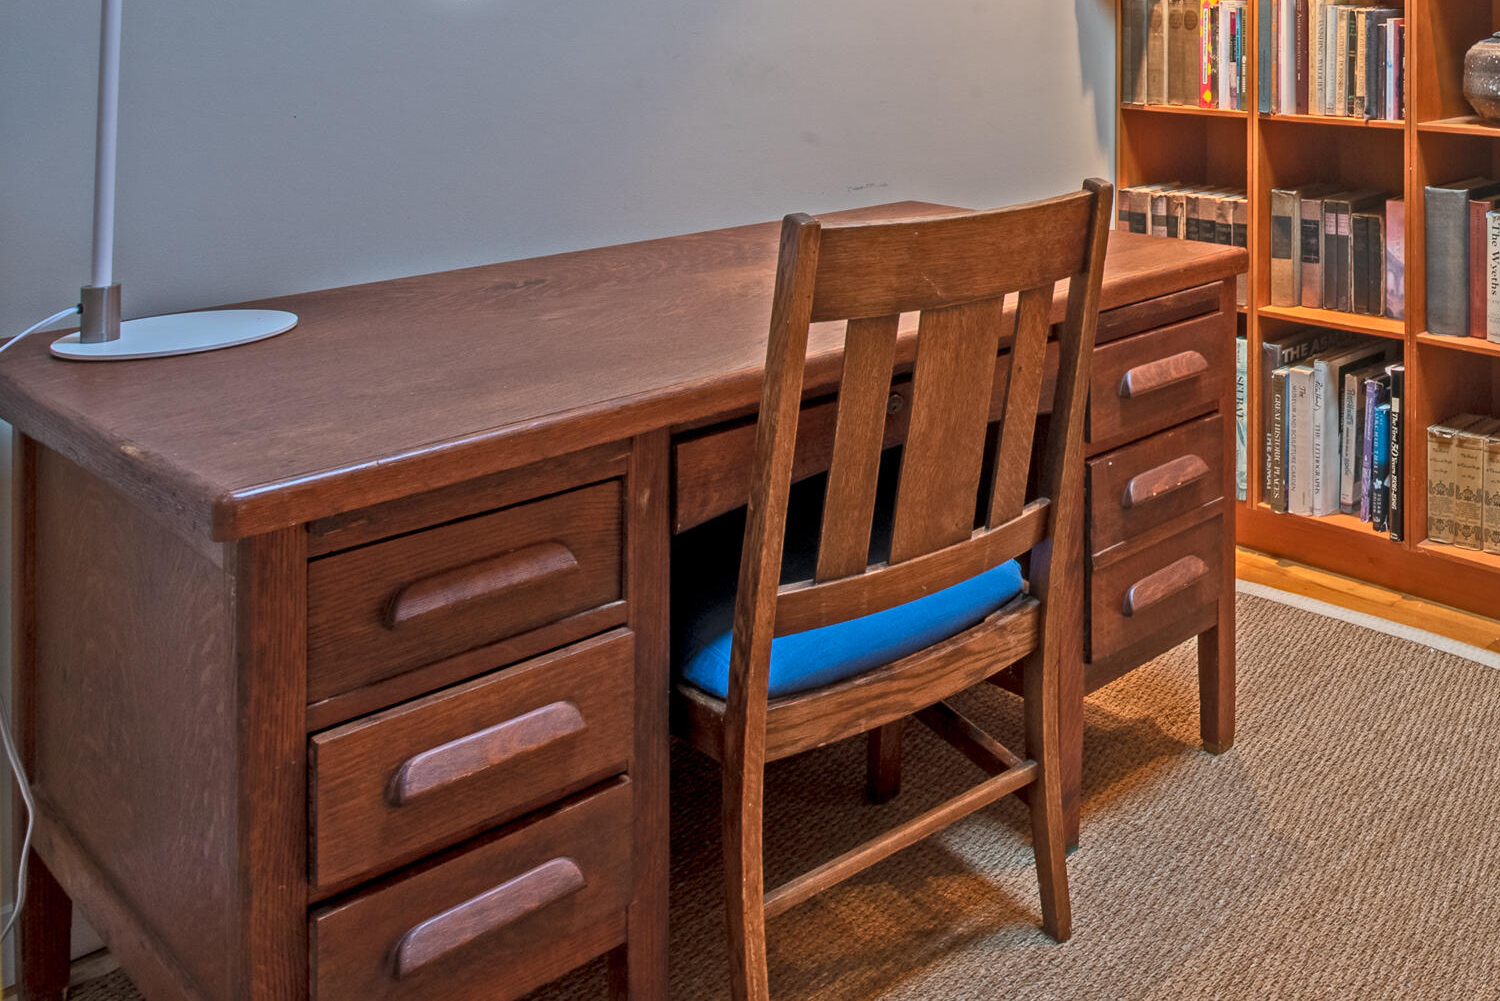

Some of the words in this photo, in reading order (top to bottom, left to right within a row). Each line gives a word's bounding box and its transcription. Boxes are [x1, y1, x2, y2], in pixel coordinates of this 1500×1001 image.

[1491, 223, 1500, 247] The
[1490, 251, 1500, 296] Wyeths
[1282, 343, 1308, 363] THE
[1391, 443, 1399, 457] 50
